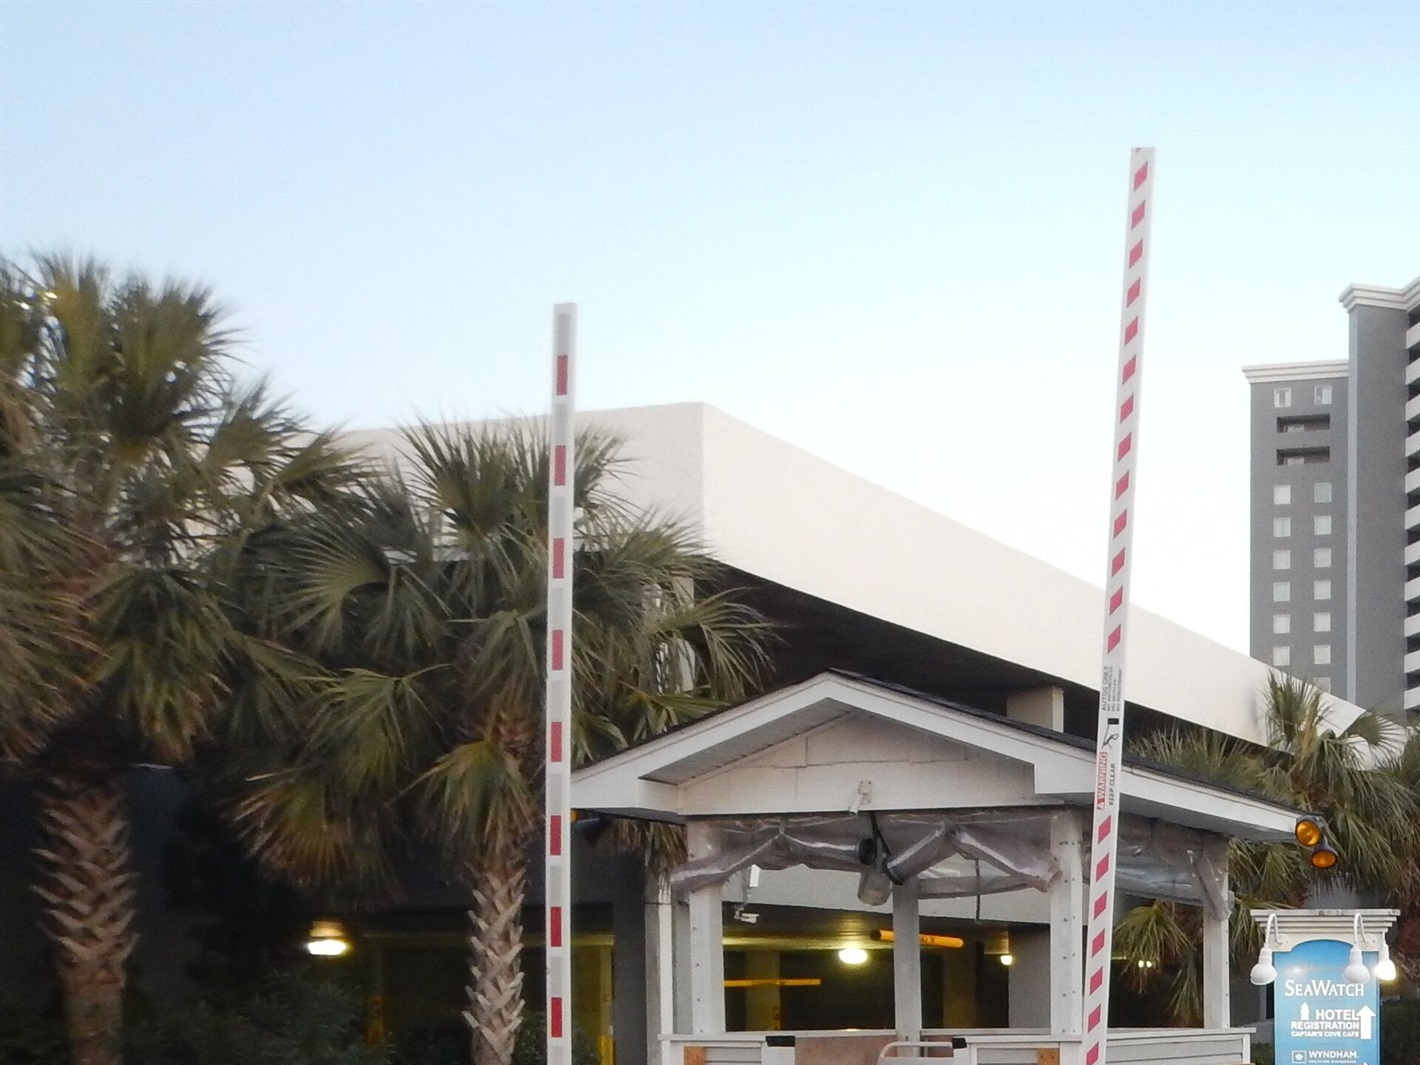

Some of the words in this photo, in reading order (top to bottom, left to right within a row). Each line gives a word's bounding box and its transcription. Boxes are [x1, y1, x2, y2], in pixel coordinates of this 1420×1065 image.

[1097, 752, 1107, 799] WARNING
[1315, 1008, 1360, 1021] HOTEL
[1290, 1021, 1360, 1030] REGISTRATION
[1308, 1050, 1357, 1059] WYNDHAM
